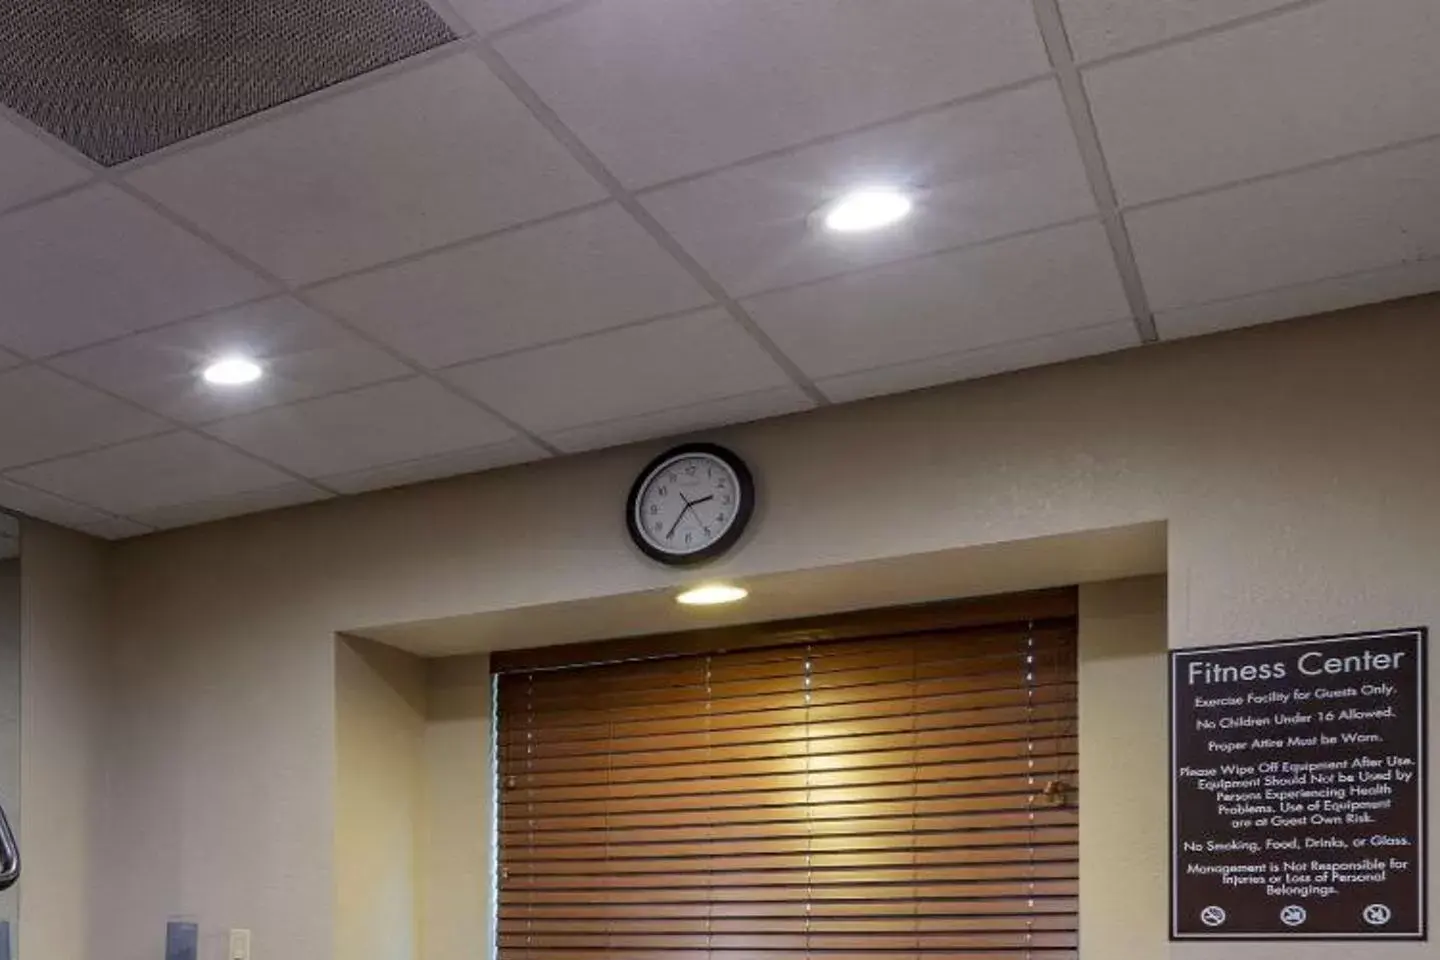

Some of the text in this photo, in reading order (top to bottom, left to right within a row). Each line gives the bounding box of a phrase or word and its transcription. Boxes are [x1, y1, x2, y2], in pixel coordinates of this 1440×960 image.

[1188, 650, 1405, 686] Fitness Center
[1195, 684, 1397, 708] Exercise Facility for Guests Only.
[1196, 706, 1397, 731] No Children Under 16 Allowed.
[1208, 740, 1247, 753] Proper
[1251, 738, 1284, 749] Attire
[1287, 736, 1318, 748] Must
[1321, 734, 1338, 745] be
[1179, 755, 1416, 778] Please Wipe Off Equipment After Use.
[1198, 769, 1413, 791] Equipment Should Not be Used by
[1216, 784, 1393, 802] Persons Experiencing Health
[1218, 798, 1391, 816] Problems. Use of Equipment
[1231, 812, 1376, 829] are at Guest Own Risk.
[1183, 841, 1203, 852] No
[1206, 839, 1261, 854] Smoking,
[1265, 838, 1300, 851] Food,
[1352, 837, 1366, 848] or
[1370, 834, 1412, 846] Glass.
[1186, 857, 1409, 876] Management is Not Responsible for
[1222, 870, 1386, 887] Injuries or Loss of Personal
[1266, 884, 1338, 898] Belongings.
